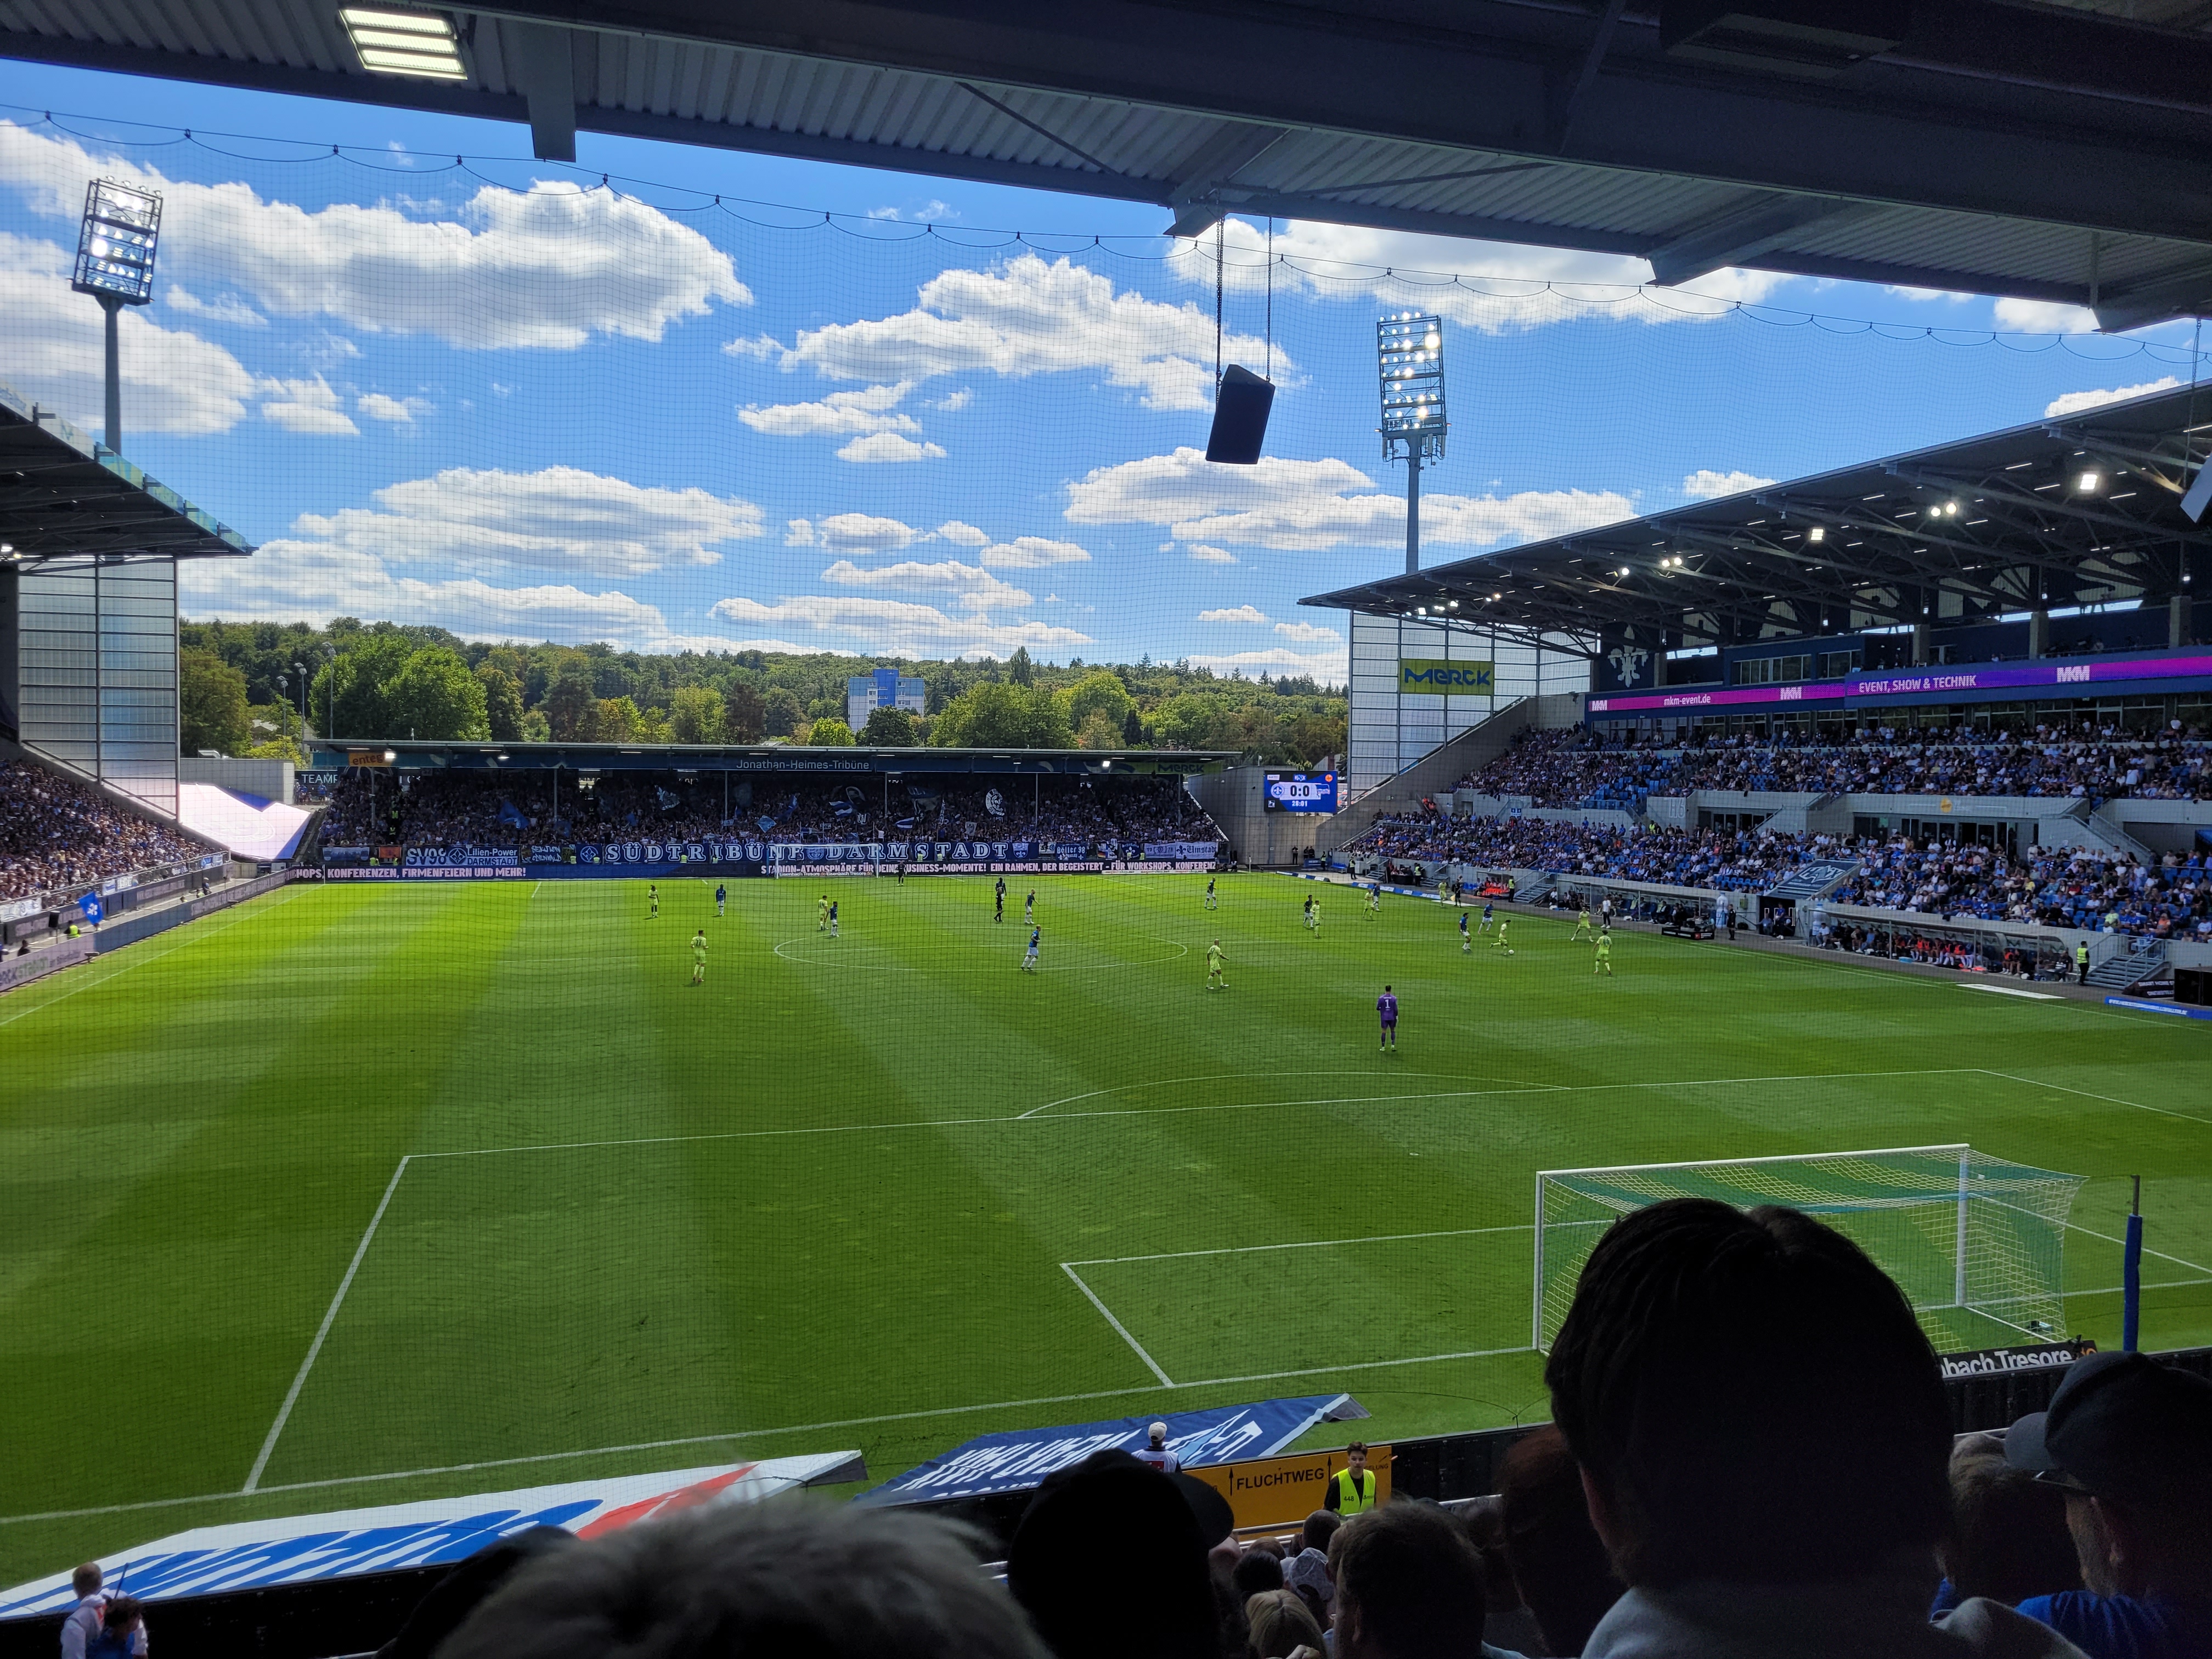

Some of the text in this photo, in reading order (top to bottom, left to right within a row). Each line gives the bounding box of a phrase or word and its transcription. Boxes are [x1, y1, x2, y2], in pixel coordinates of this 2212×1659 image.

[1859, 675, 1977, 693] EVENT, SHOW & TECHNIK
[1663, 693, 1711, 707] mkm-event.de
[352, 753, 385, 765] enteg
[736, 759, 870, 770] Jonathan-Heimes-Tribüne
[1290, 785, 1310, 797] 0:0
[407, 848, 447, 865] SV98
[467, 848, 517, 856] Lilien-Power
[826, 842, 1008, 860] DARMSTADT
[1057, 846, 1086, 854] Böller 98
[327, 868, 400, 879] KONFERENZEN,
[402, 867, 472, 878] FIRMENFEIERN
[474, 867, 494, 877] UND
[495, 867, 526, 877] MEHR!
[761, 862, 856, 874] STADION-ATMOSPHÄRE
[859, 862, 875, 873] FÜR
[990, 863, 1003, 871] EIN
[1005, 862, 1041, 872] RAHMEN,
[1042, 862, 1057, 871] DER
[1059, 862, 1104, 871] BEGEISTERT
[1111, 860, 1125, 870] FÜR
[1127, 861, 1174, 871] WORKSHOPS,
[1175, 861, 1216, 870] KONFERENZ
[1385, 999, 1391, 1009] 1
[1994, 1350, 2073, 1370] Tresore
[1237, 1468, 1324, 1491] FLUCHTWEG
